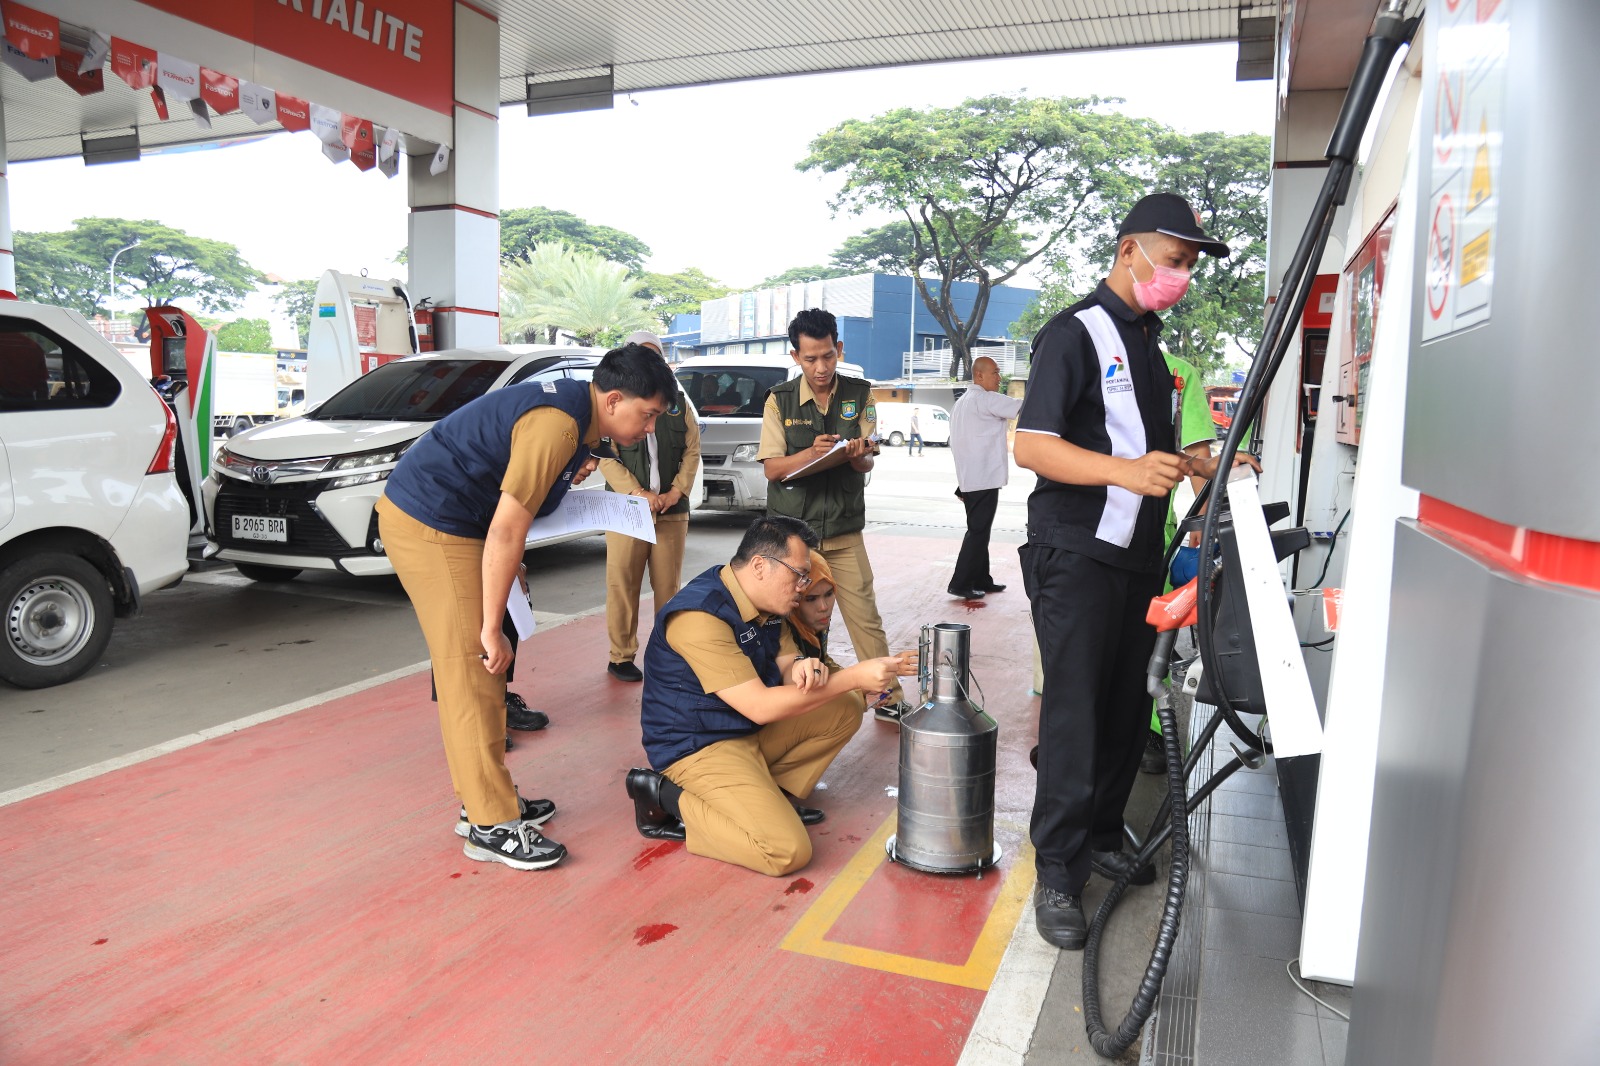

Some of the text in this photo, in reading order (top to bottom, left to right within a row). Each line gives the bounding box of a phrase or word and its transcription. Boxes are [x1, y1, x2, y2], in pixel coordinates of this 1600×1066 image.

[205, 83, 235, 98] Fastron
[313, 117, 338, 130] Fastron
[235, 518, 285, 533] B 2965 BRA
[501, 838, 519, 854] N
